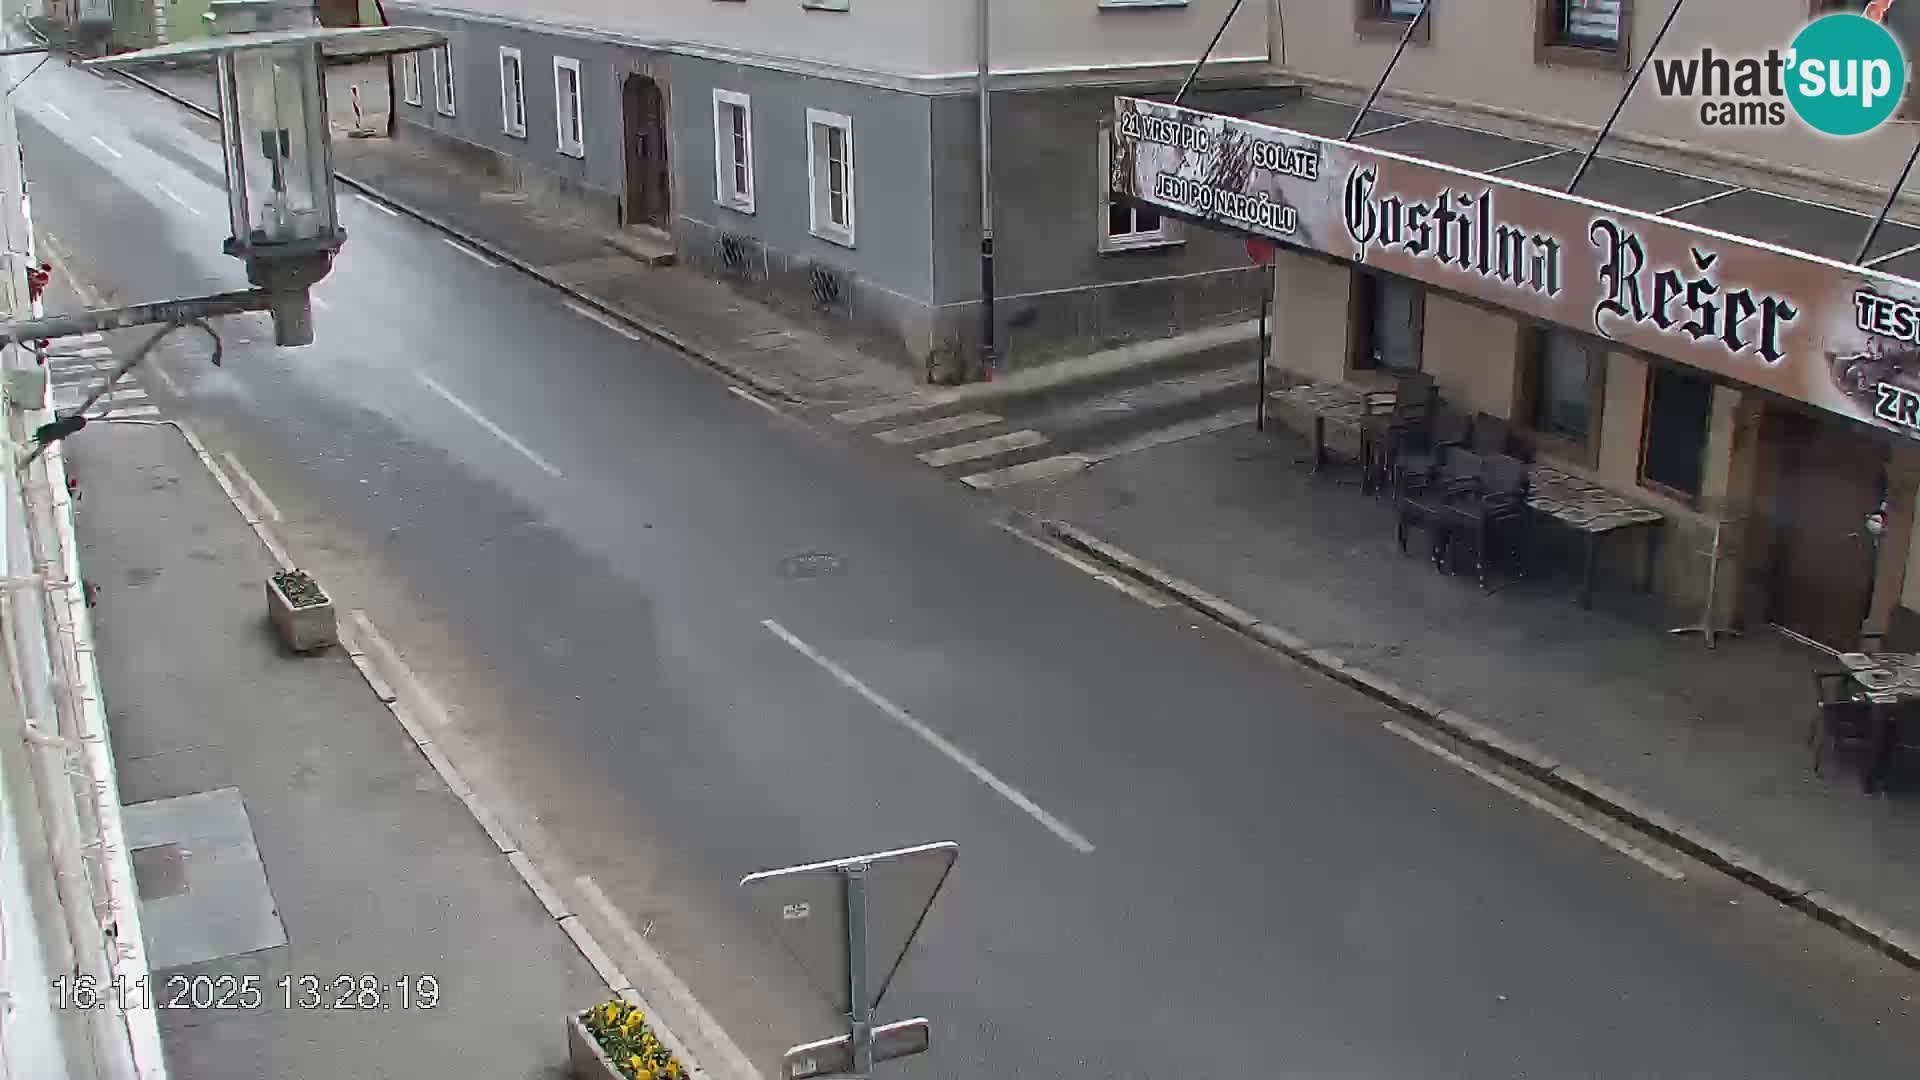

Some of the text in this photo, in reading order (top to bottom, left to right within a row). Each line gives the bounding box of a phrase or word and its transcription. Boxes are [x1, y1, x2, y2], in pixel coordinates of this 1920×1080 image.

[1122, 112, 1140, 138] 21
[1143, 116, 1181, 145] VRST
[1253, 141, 1317, 180] SOLATE
[1155, 173, 1297, 235] JEDI PO NAROČILU
[1344, 162, 1799, 363] Gostilna Rešer
